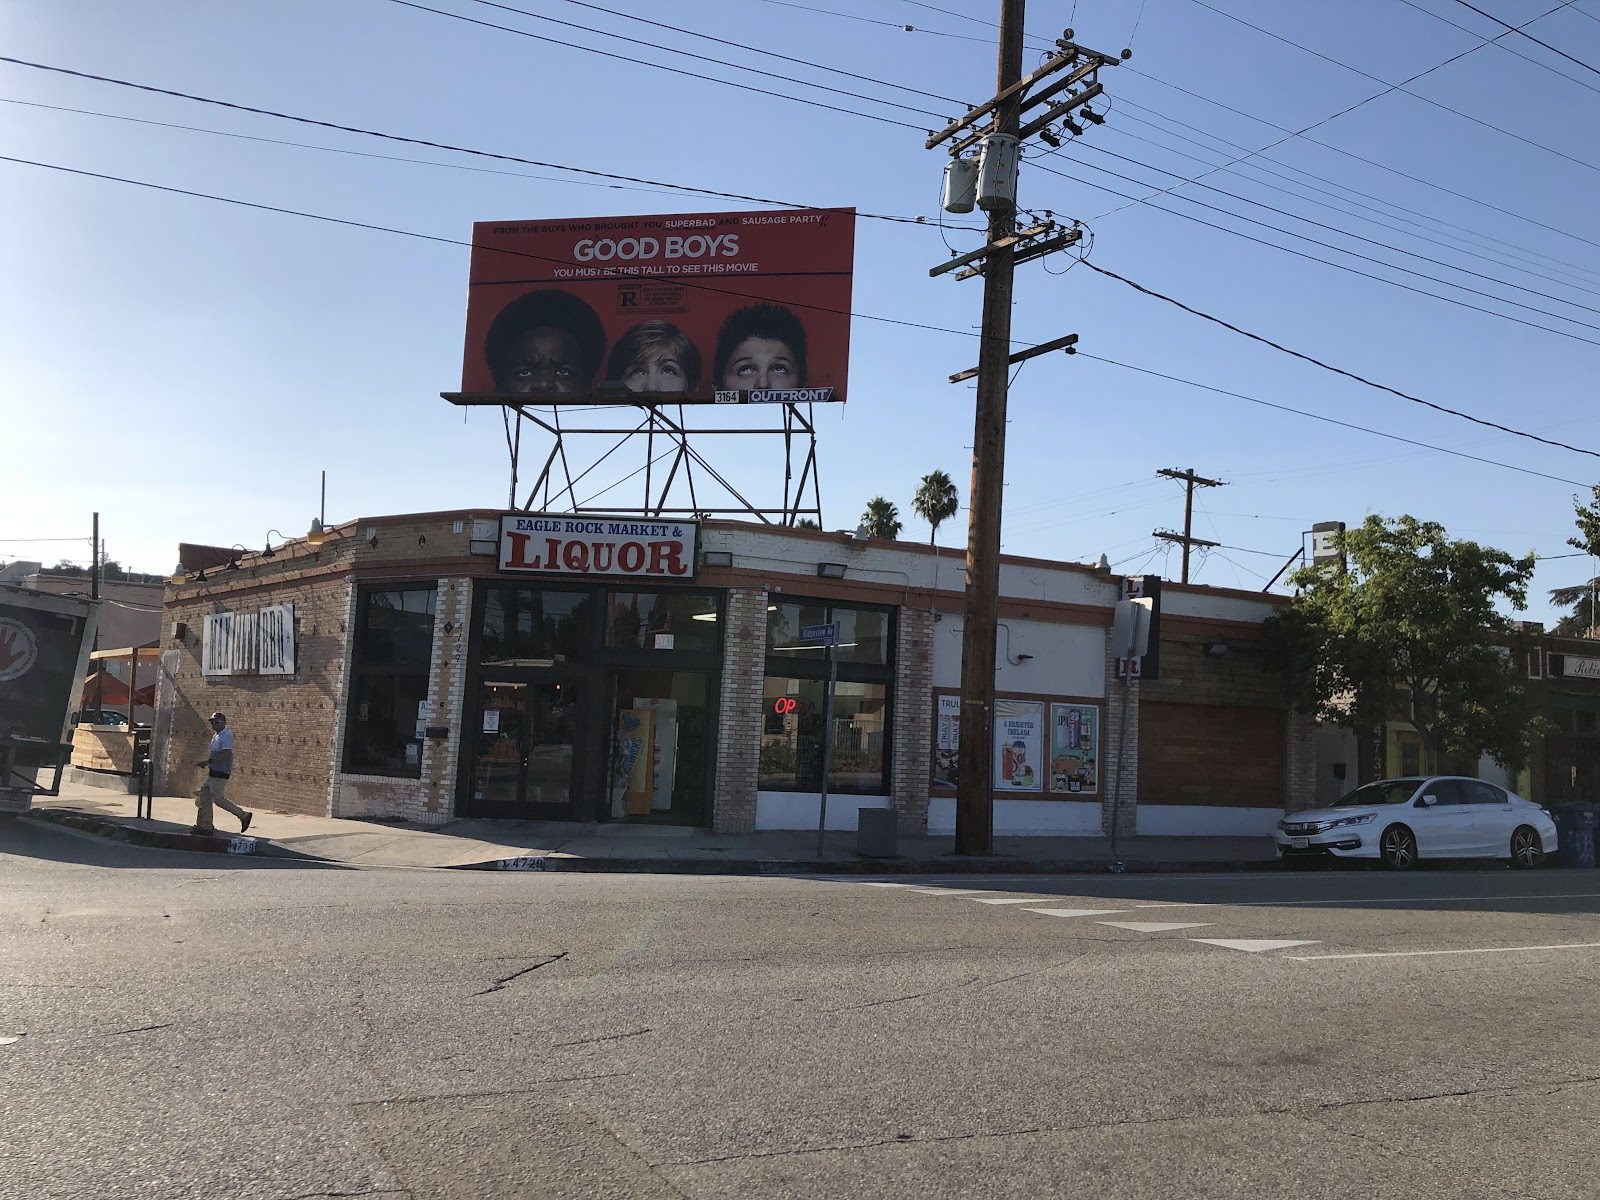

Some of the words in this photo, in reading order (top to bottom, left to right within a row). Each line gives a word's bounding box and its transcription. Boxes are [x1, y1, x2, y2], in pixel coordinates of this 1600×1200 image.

[493, 226, 519, 235] FROM
[522, 226, 539, 234] THE
[541, 225, 566, 233] GUYS
[568, 224, 592, 232] WHO
[594, 221, 639, 231] BROUGHT
[665, 218, 716, 228] SUPERBAD
[718, 217, 739, 225] AND
[742, 216, 786, 225] SAUSAGE
[789, 214, 822, 223] PARTY
[573, 237, 660, 262] GOOD
[664, 233, 740, 259] BOYS
[553, 269, 574, 277] YOU
[575, 267, 601, 277] MUST
[603, 267, 617, 276] BE
[618, 266, 639, 275] THIS
[641, 265, 665, 274] TALL
[666, 265, 680, 274] TO
[681, 264, 700, 273] SEE
[702, 263, 725, 273] THIS
[726, 262, 759, 272] MOVIE
[620, 291, 639, 307] R
[716, 391, 737, 402] 3164
[751, 389, 828, 402] OUTFRONT
[515, 519, 561, 532] EAGLE
[565, 522, 604, 534] ROCK
[607, 523, 669, 537] MARKET
[672, 525, 683, 538] &
[504, 530, 688, 575] LIQUOR
[262, 610, 285, 672] BBQ
[941, 699, 961, 708] TRUL
[232, 841, 255, 852] 4729
[512, 857, 543, 869] 4729
